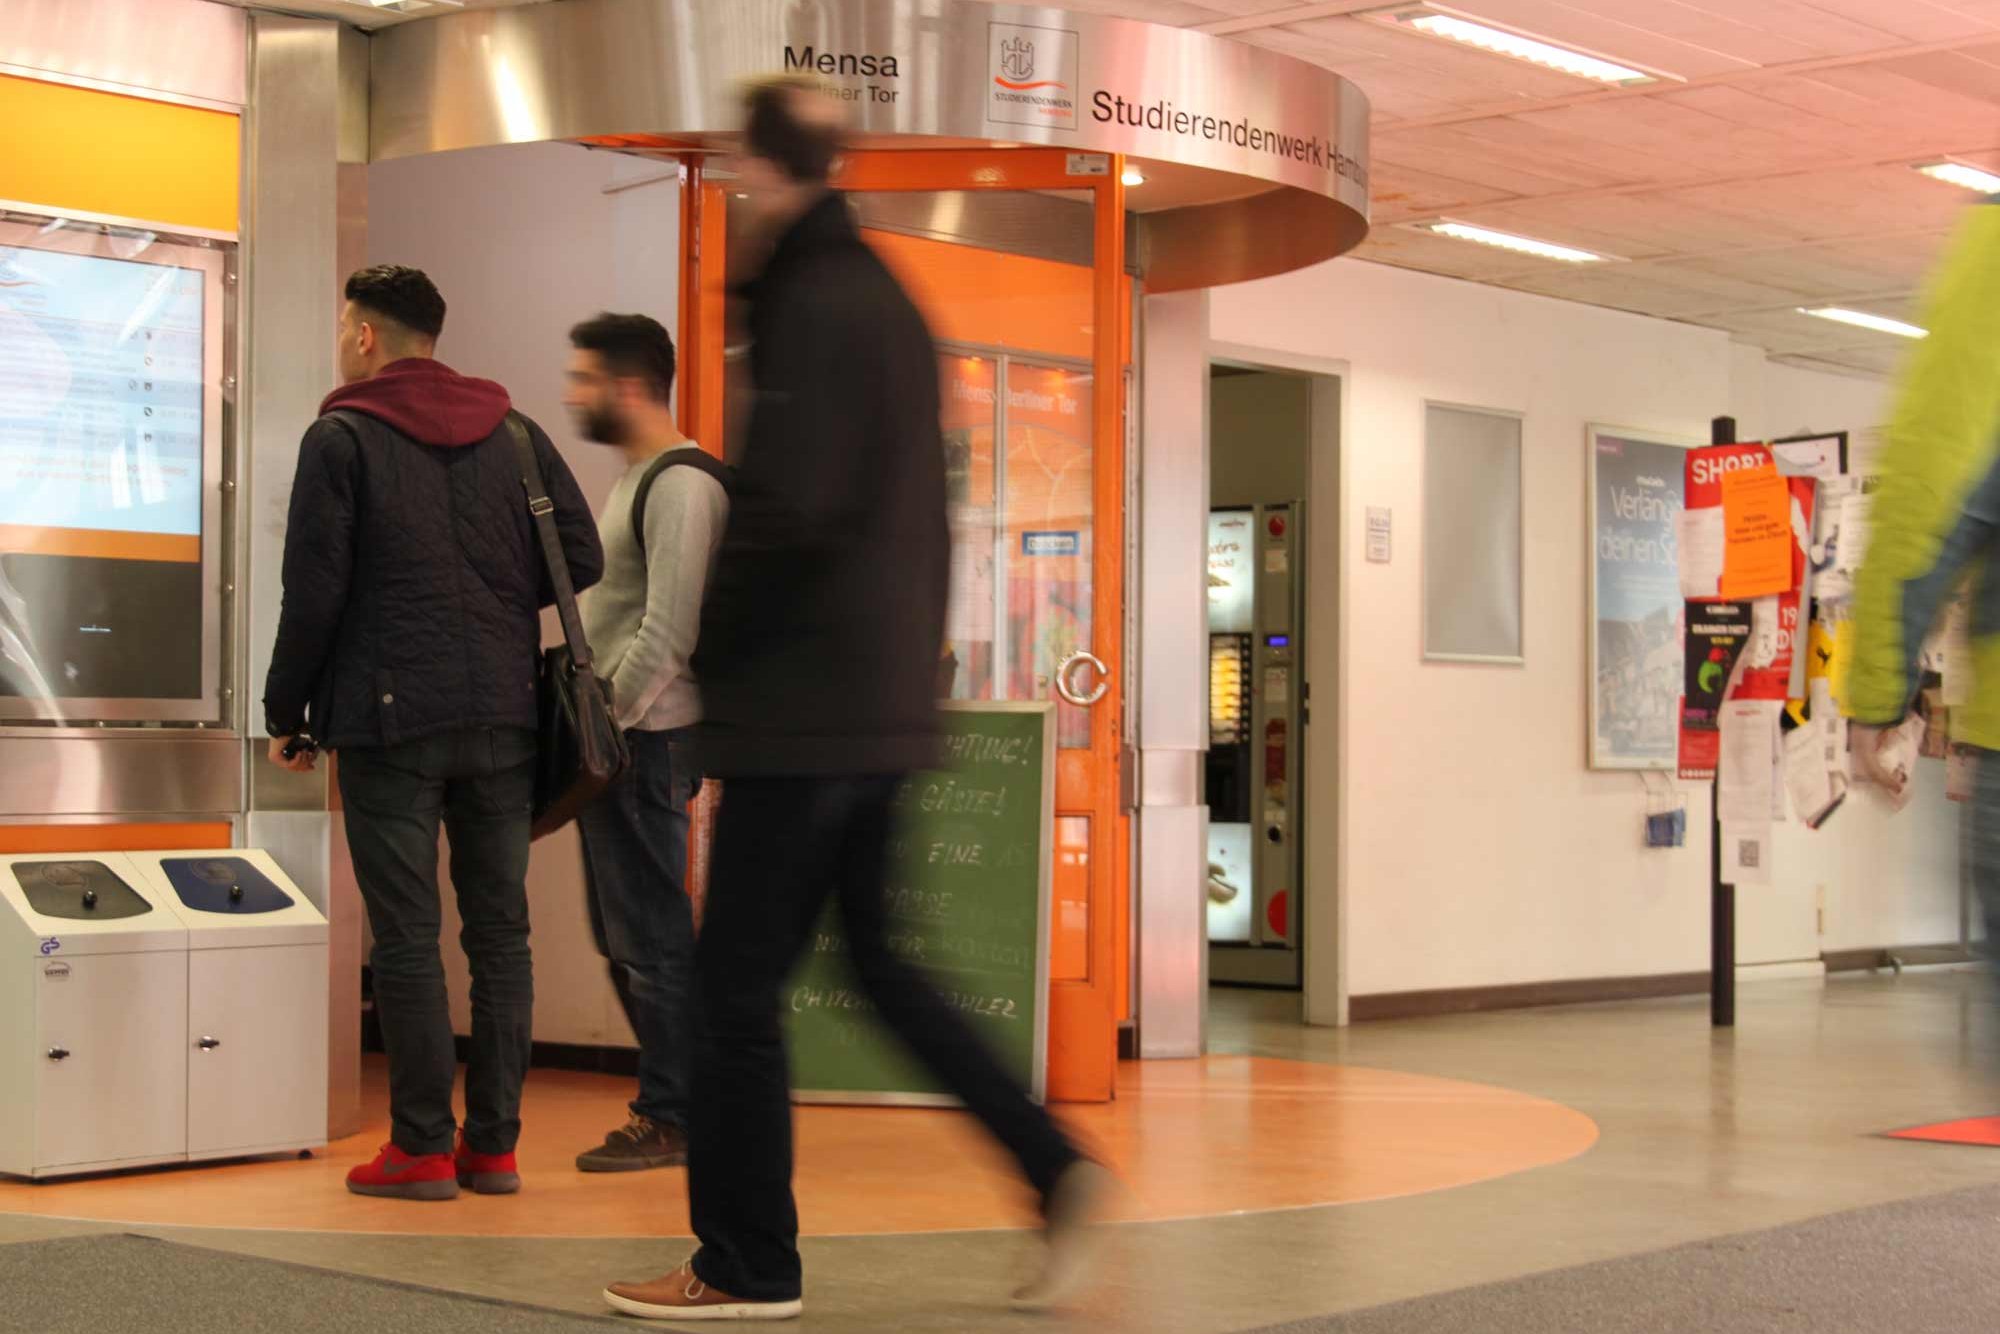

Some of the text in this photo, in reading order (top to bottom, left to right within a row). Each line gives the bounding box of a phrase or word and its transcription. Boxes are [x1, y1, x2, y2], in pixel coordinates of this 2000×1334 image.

[783, 46, 899, 77] Mensa
[867, 85, 899, 103] Tor
[1092, 90, 1323, 168] Studierendenwerk
